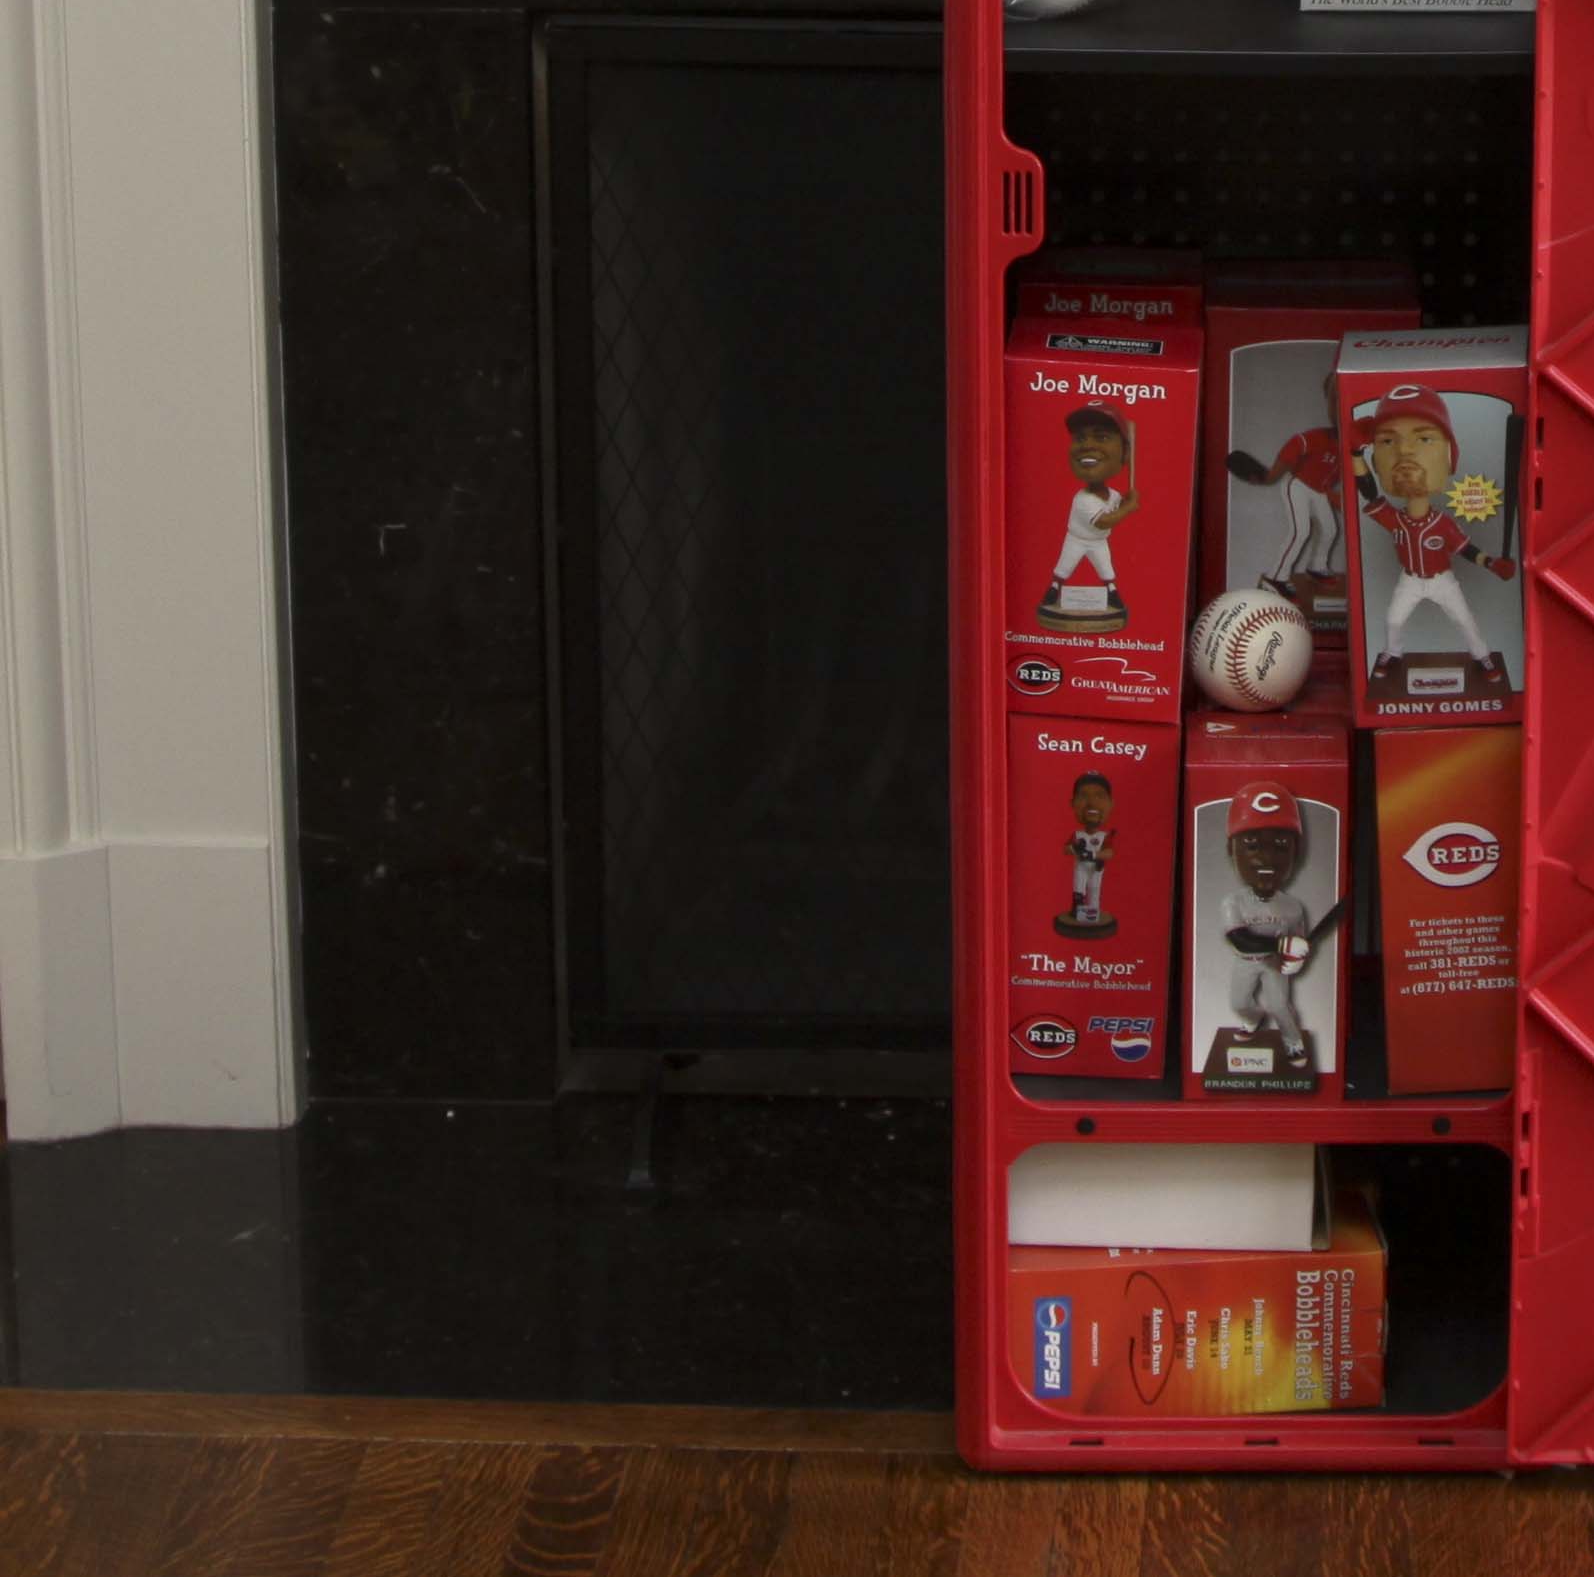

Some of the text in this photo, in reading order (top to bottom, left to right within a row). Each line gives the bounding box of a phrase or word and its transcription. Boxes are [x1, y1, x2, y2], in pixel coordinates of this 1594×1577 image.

[1044, 294, 1174, 320] Joe Morgan
[1353, 335, 1512, 350] Champion
[1030, 371, 1167, 405] Joe Morgan
[1005, 631, 1164, 651] Commemorative Bobblehead
[1256, 631, 1283, 681] Rawlings
[1019, 669, 1061, 682] REDS
[1378, 700, 1503, 715] JONNY GOMES
[1037, 733, 1147, 761] Sean Casey
[1430, 844, 1500, 865] REDS
[1415, 926, 1500, 937] and other games
[1428, 918, 1463, 927] tickets
[1465, 917, 1476, 926] to
[1419, 936, 1476, 947] throughout
[1404, 947, 1445, 958] historic
[1021, 954, 1144, 979] "The Mayor"
[1408, 962, 1428, 971] call
[1430, 955, 1497, 970] 381-REDS
[1011, 975, 1152, 991] Commemorative Bobblehead
[1438, 969, 1480, 979] toll-free
[1412, 981, 1445, 996] (877)
[1087, 1016, 1155, 1034] PEPSI
[1030, 1030, 1076, 1044] REDS
[1220, 1307, 1231, 1339] Chris
[1152, 1307, 1164, 1375] Adam Dunn
[1186, 1310, 1197, 1370] Eric Davis
[1295, 1270, 1321, 1401] Bobbleheads
[1322, 1269, 1339, 1400] Commemorative
[1339, 1268, 1355, 1399] Cincinnati Reds
[1044, 1330, 1061, 1390] PEPSI
